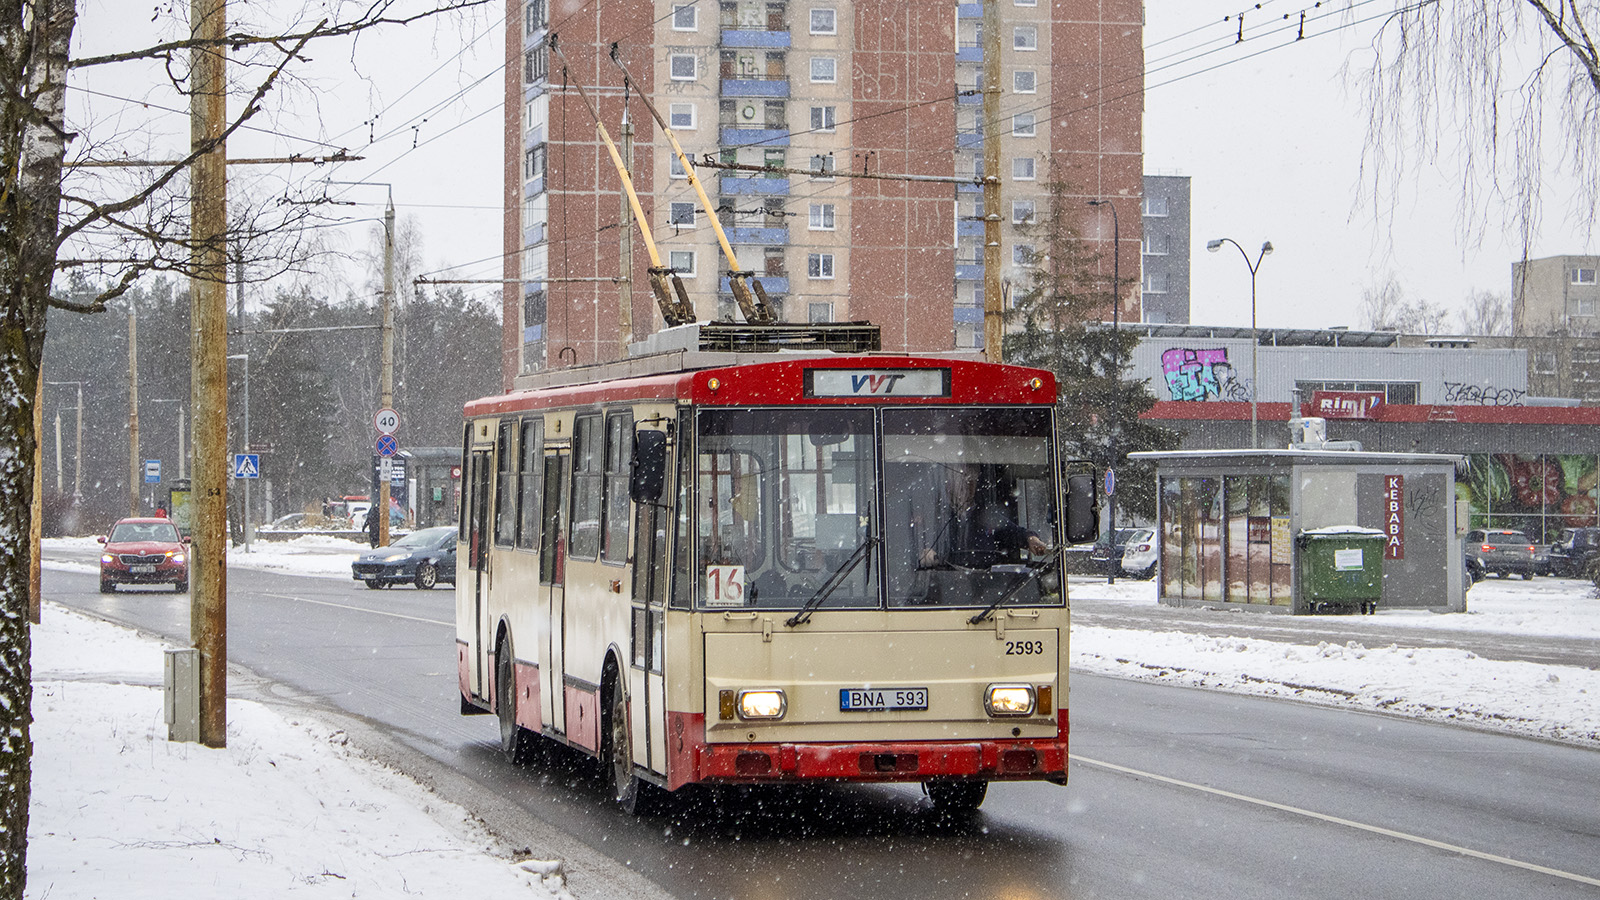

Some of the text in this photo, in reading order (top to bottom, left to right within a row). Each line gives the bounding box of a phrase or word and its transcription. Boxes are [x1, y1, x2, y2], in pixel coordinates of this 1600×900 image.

[851, 374, 906, 393] VVT
[380, 416, 396, 427] 40
[1388, 477, 1401, 557] KEBABAI
[708, 568, 743, 601] 16
[1005, 640, 1044, 656] 2593
[851, 692, 885, 707] BNA
[896, 691, 924, 706] 593
